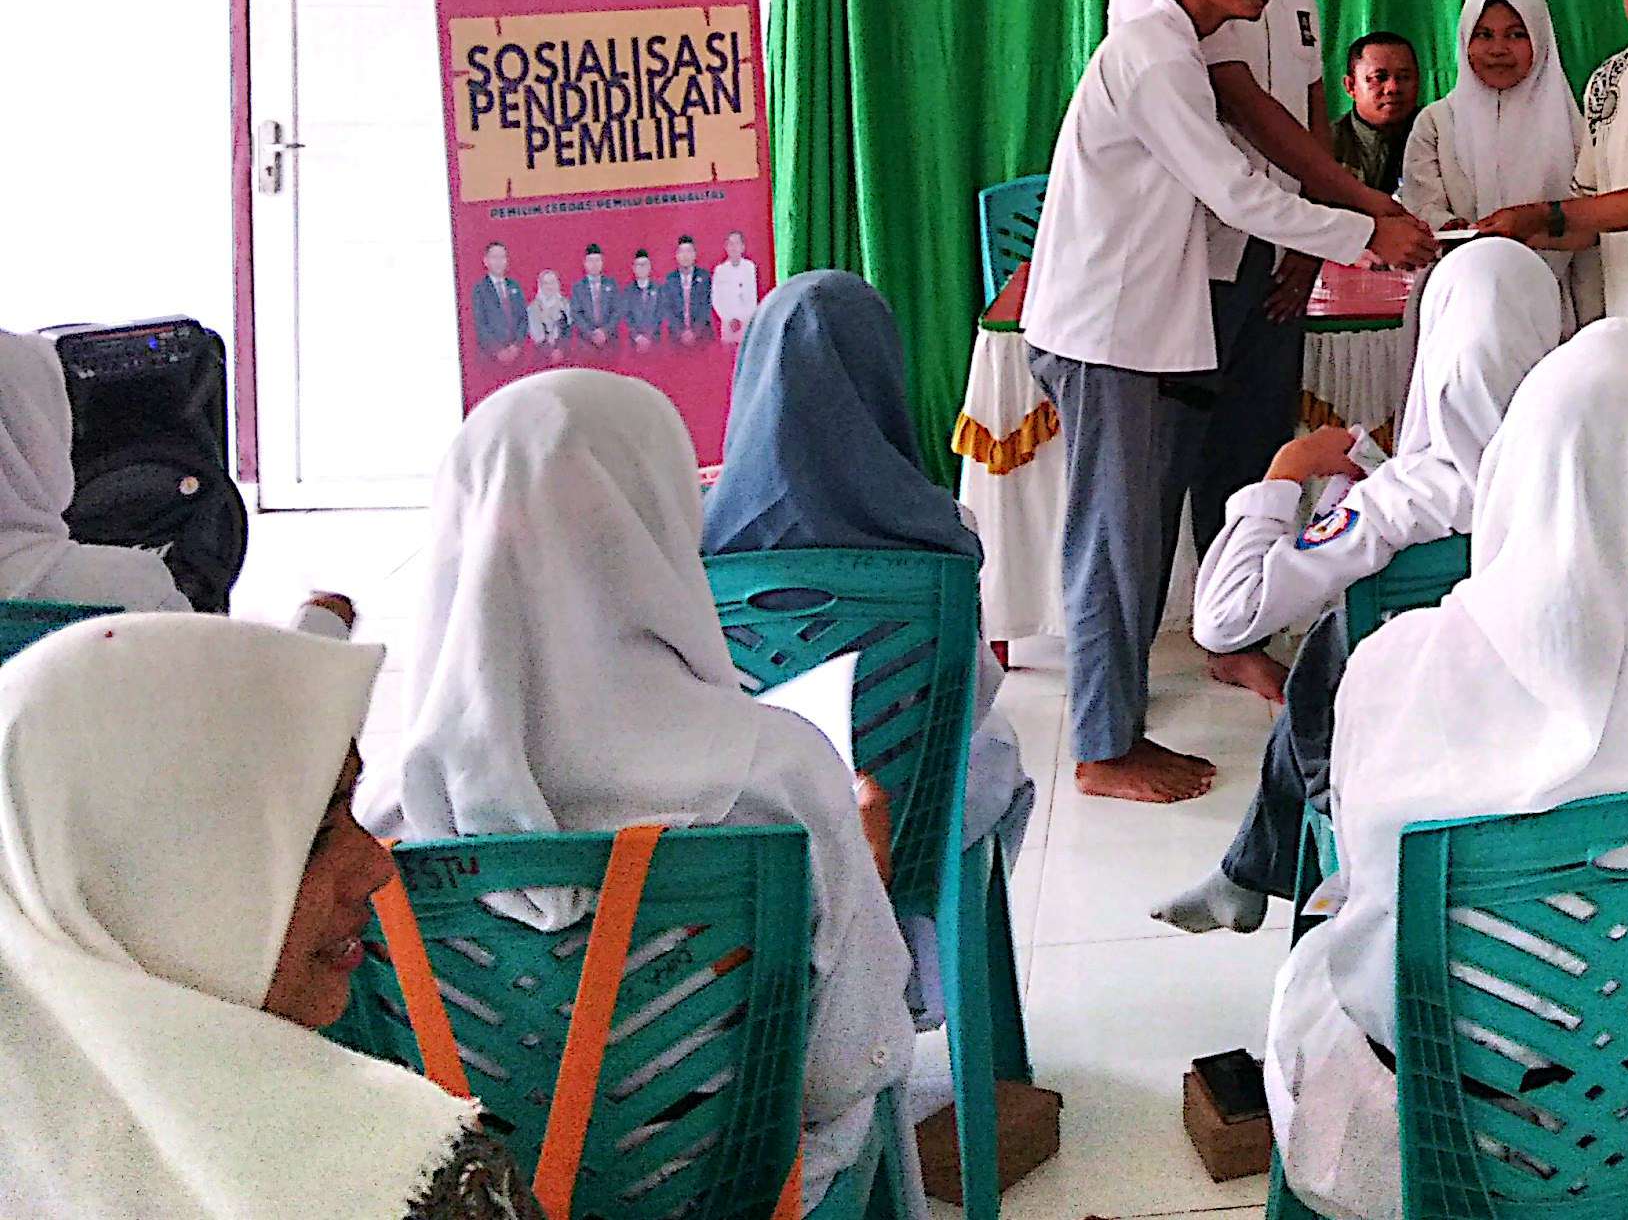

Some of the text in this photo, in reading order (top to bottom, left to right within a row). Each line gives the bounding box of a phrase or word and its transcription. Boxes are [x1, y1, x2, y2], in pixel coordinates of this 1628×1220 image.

[467, 31, 740, 86] SOSIALISASI
[468, 75, 741, 131] PENDIDIKAN
[526, 115, 696, 169] PEMILIH
